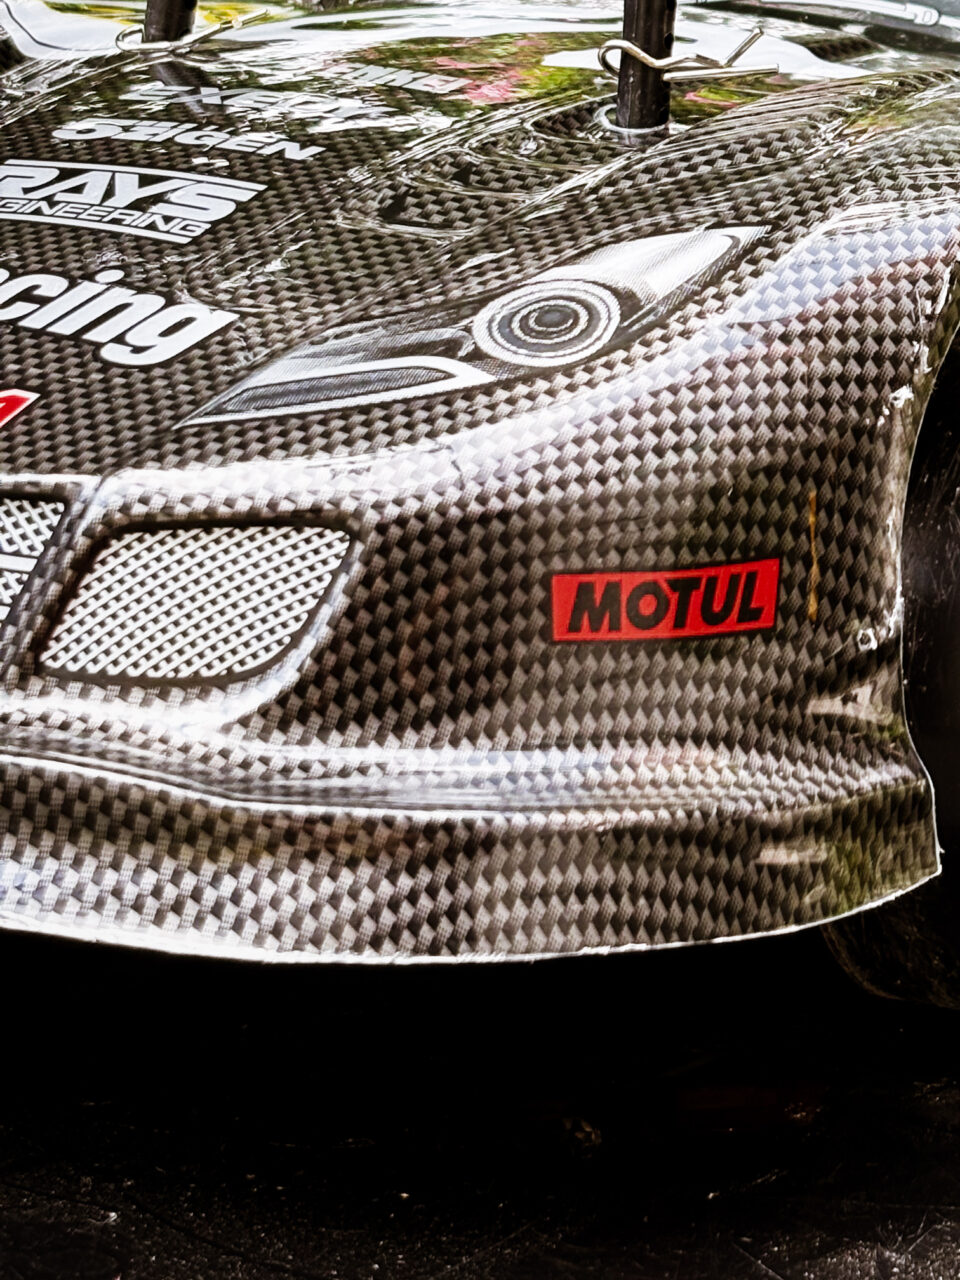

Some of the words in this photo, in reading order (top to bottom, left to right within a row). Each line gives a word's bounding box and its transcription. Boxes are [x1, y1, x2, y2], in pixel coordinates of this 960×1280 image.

[0, 165, 258, 221] RAYS
[0, 269, 240, 365] cing
[567, 571, 764, 633] MOTUL
